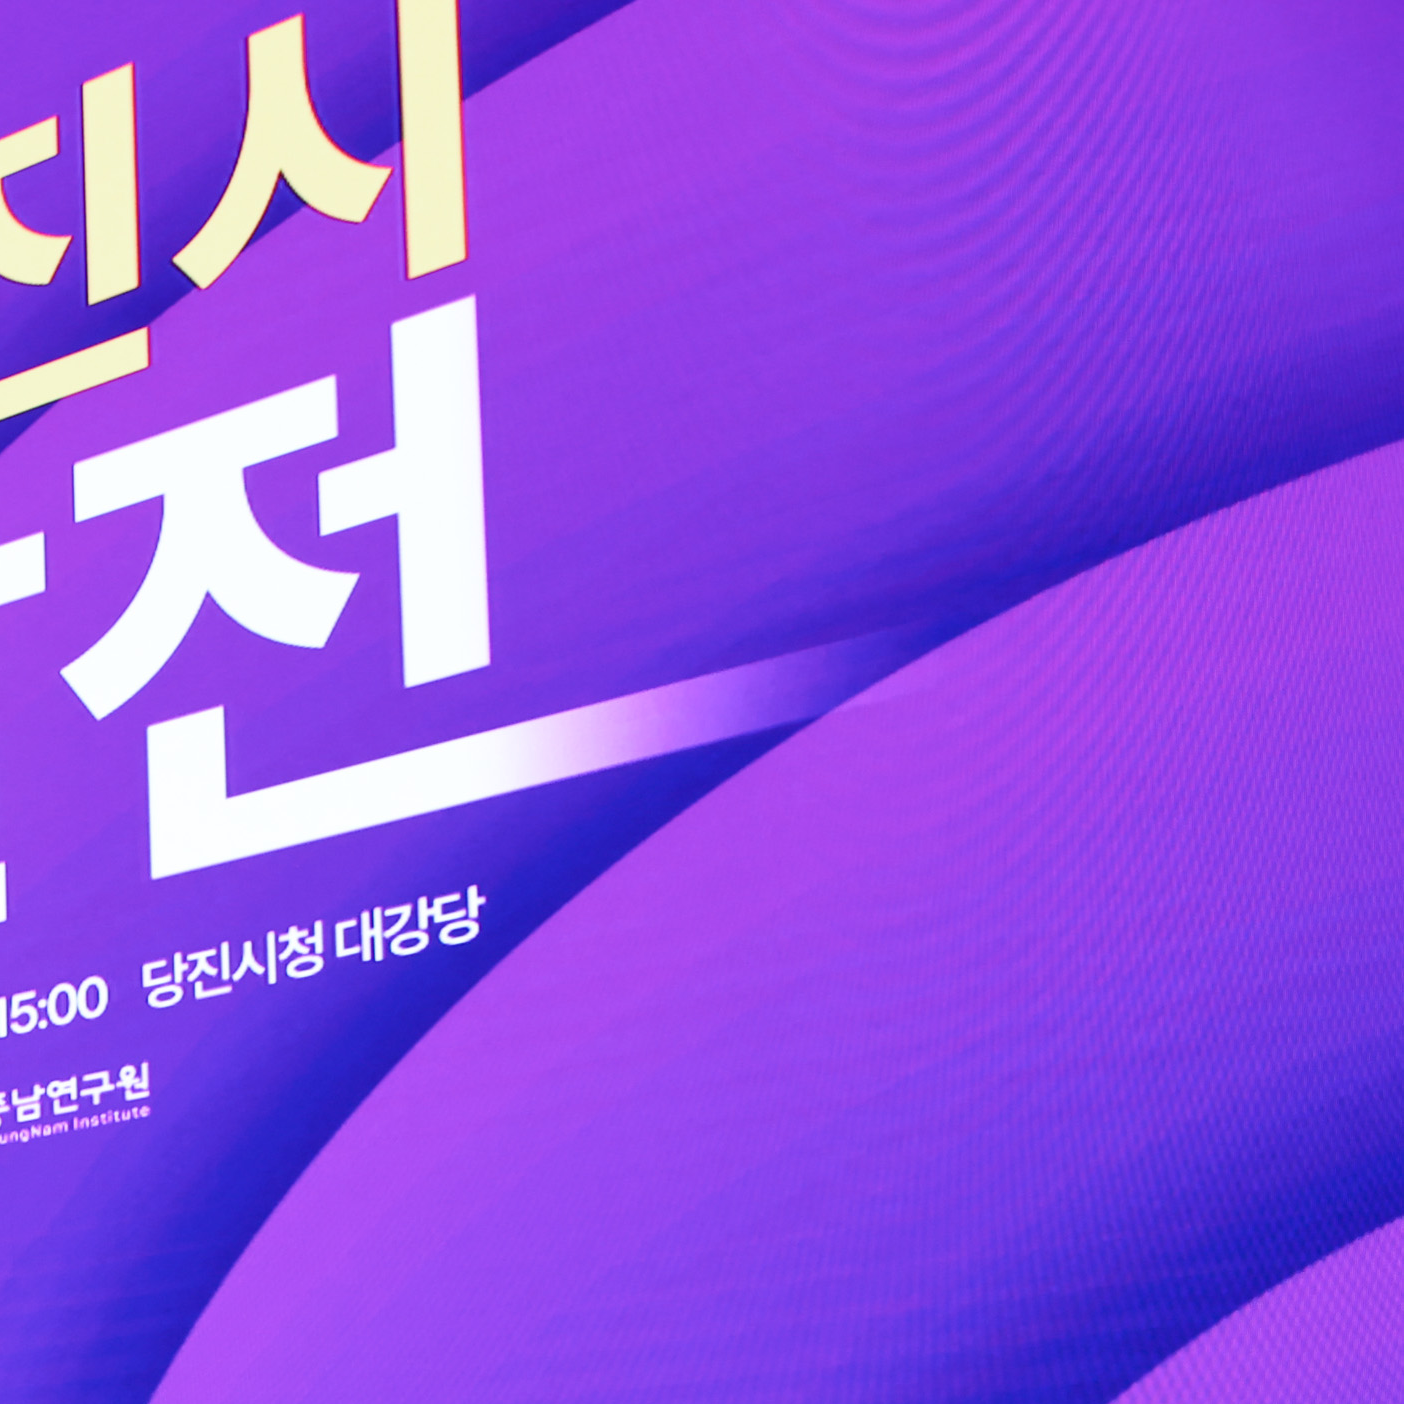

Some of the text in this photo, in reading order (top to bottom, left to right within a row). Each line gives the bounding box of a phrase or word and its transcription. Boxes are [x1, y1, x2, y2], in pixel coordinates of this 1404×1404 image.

[141, 919, 325, 1009] 당진시청
[334, 884, 487, 963] 대강당
[73, 1104, 152, 1132] Institute
